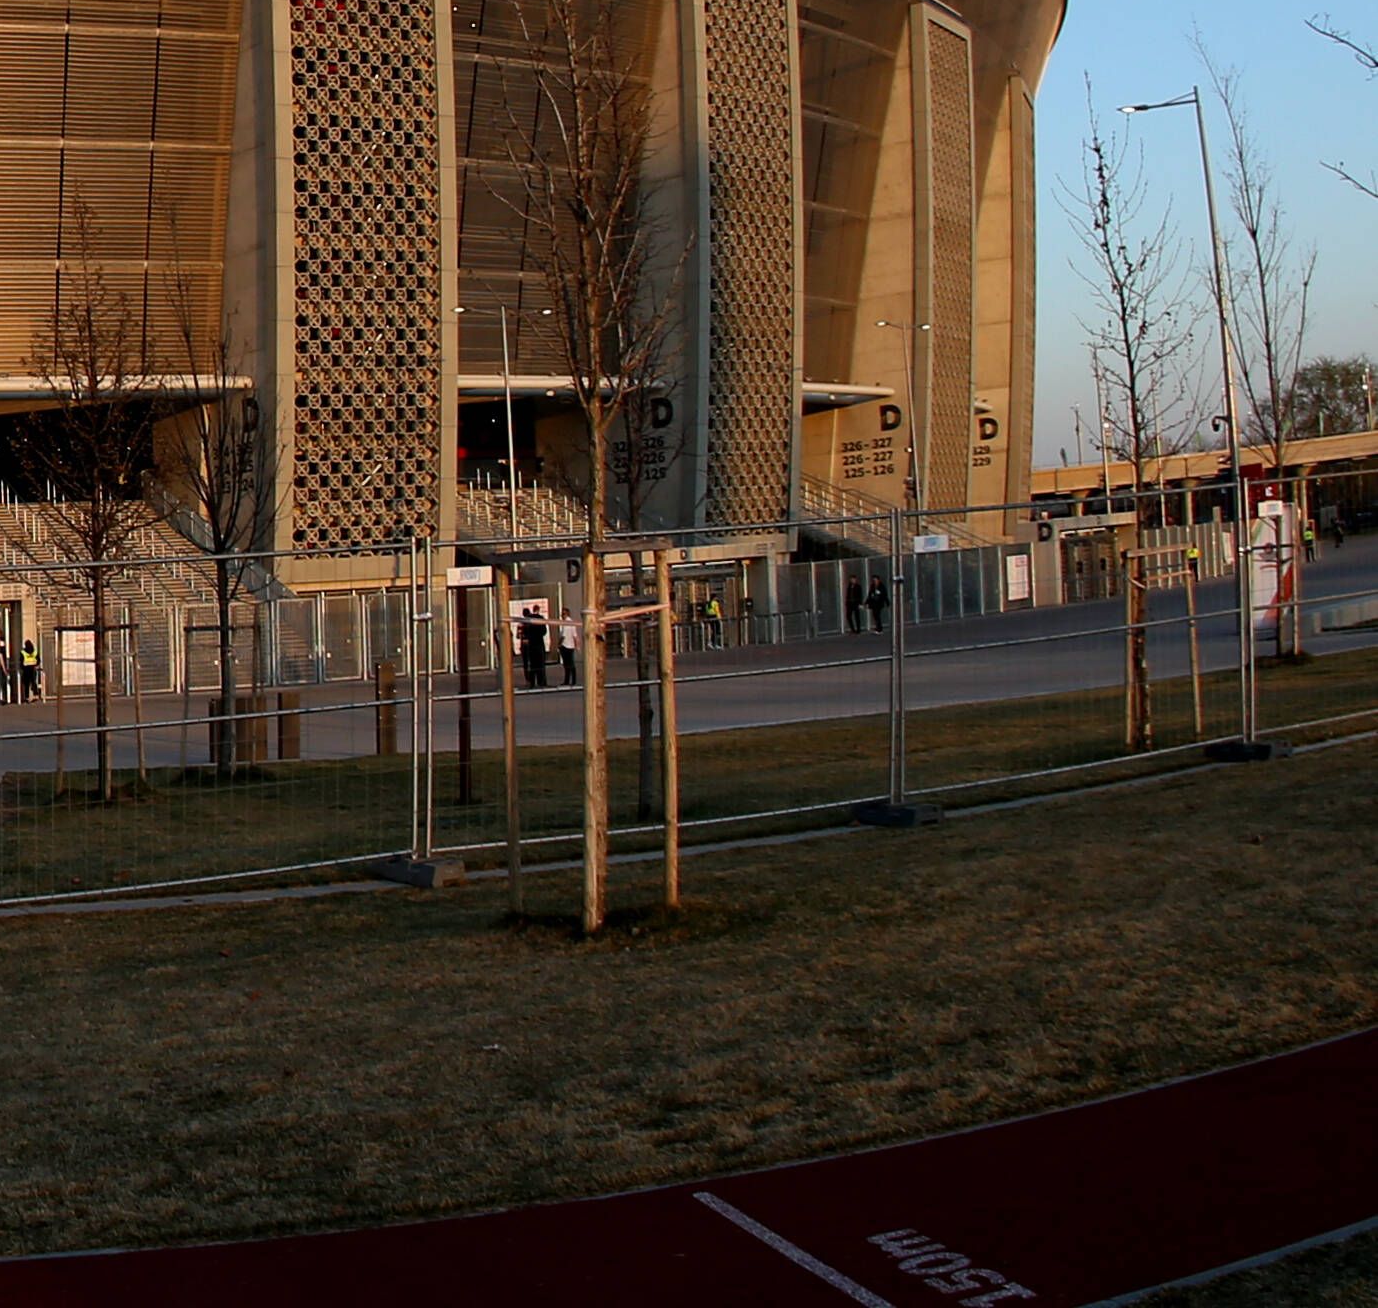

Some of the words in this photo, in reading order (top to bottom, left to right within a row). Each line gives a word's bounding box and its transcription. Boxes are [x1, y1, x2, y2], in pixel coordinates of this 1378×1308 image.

[651, 397, 673, 429] D
[879, 404, 901, 431] D
[979, 418, 999, 440] D
[841, 441, 862, 453] 326
[872, 437, 892, 449] 327
[842, 454, 863, 466] 226
[873, 451, 893, 462] 227
[1038, 522, 1053, 542] D
[567, 559, 581, 583] D
